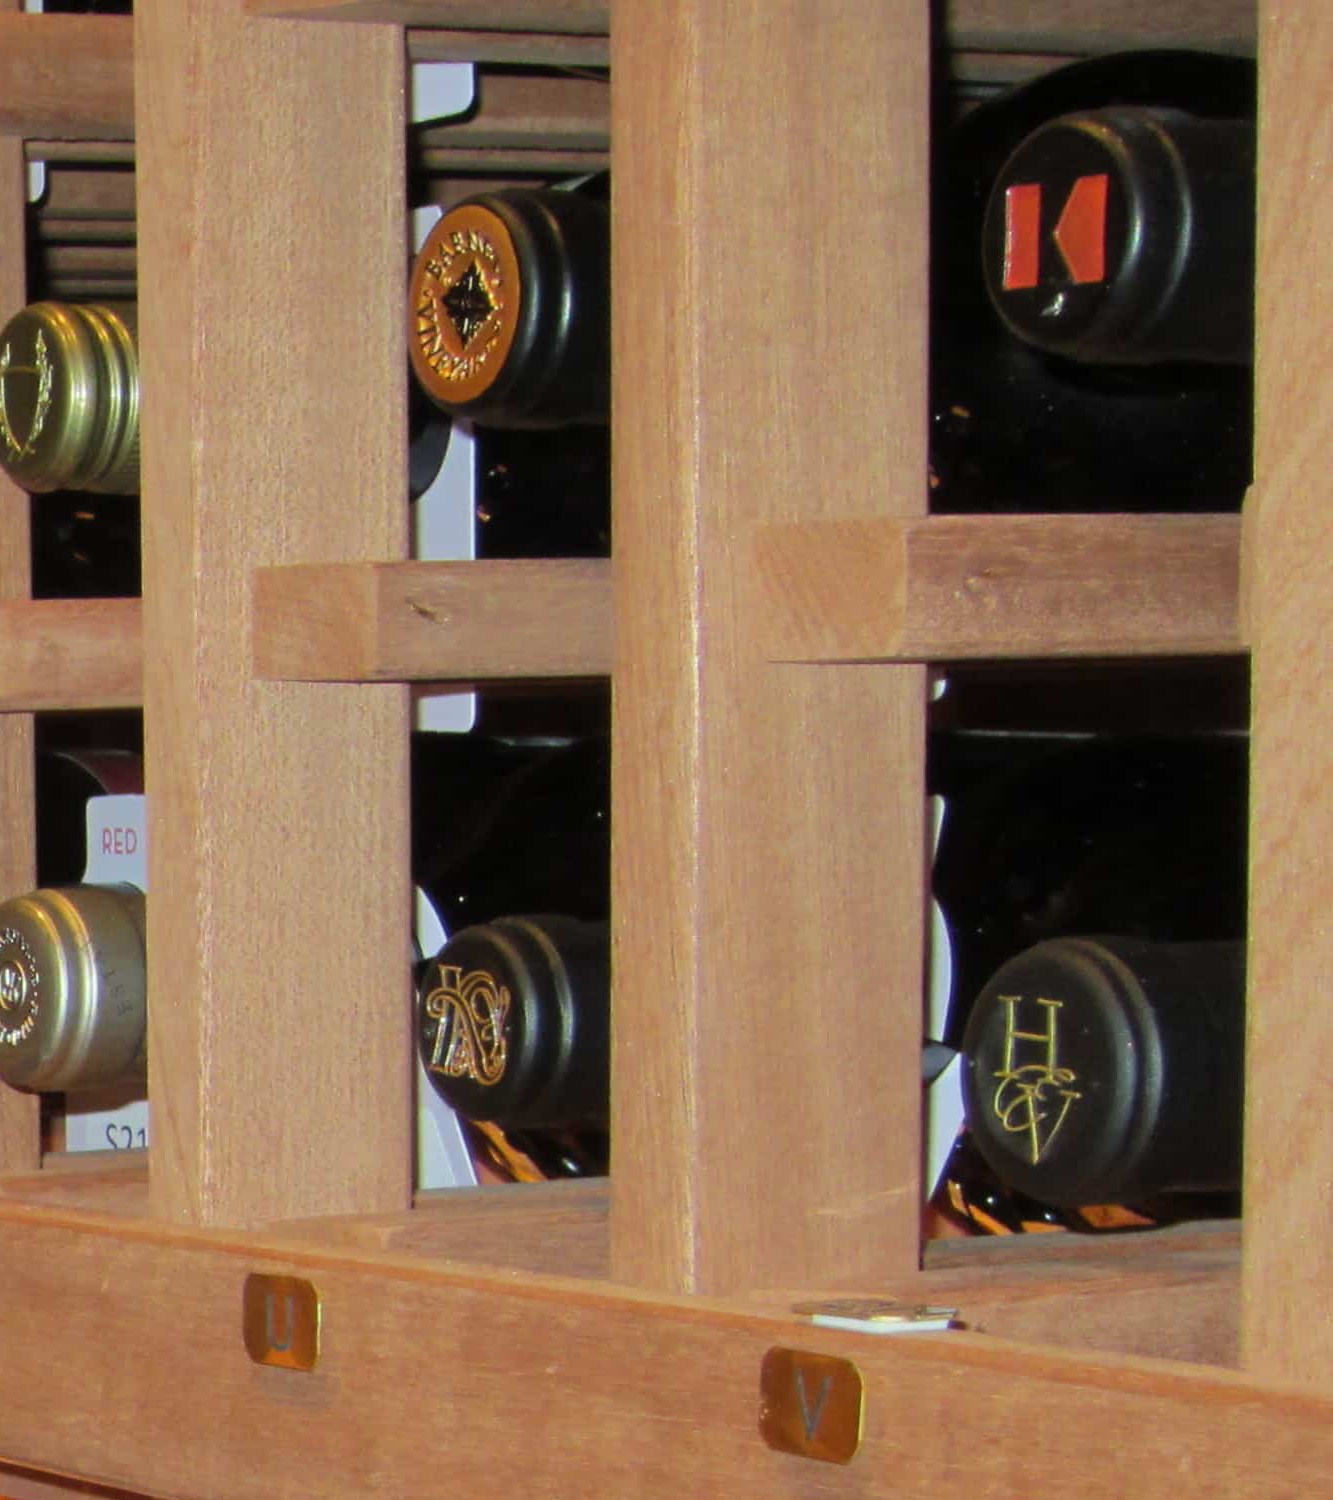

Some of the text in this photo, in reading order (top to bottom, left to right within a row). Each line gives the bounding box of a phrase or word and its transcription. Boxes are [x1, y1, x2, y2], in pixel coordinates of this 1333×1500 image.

[101, 827, 139, 855] RED
[266, 1294, 294, 1351] U
[796, 1367, 833, 1440] V
